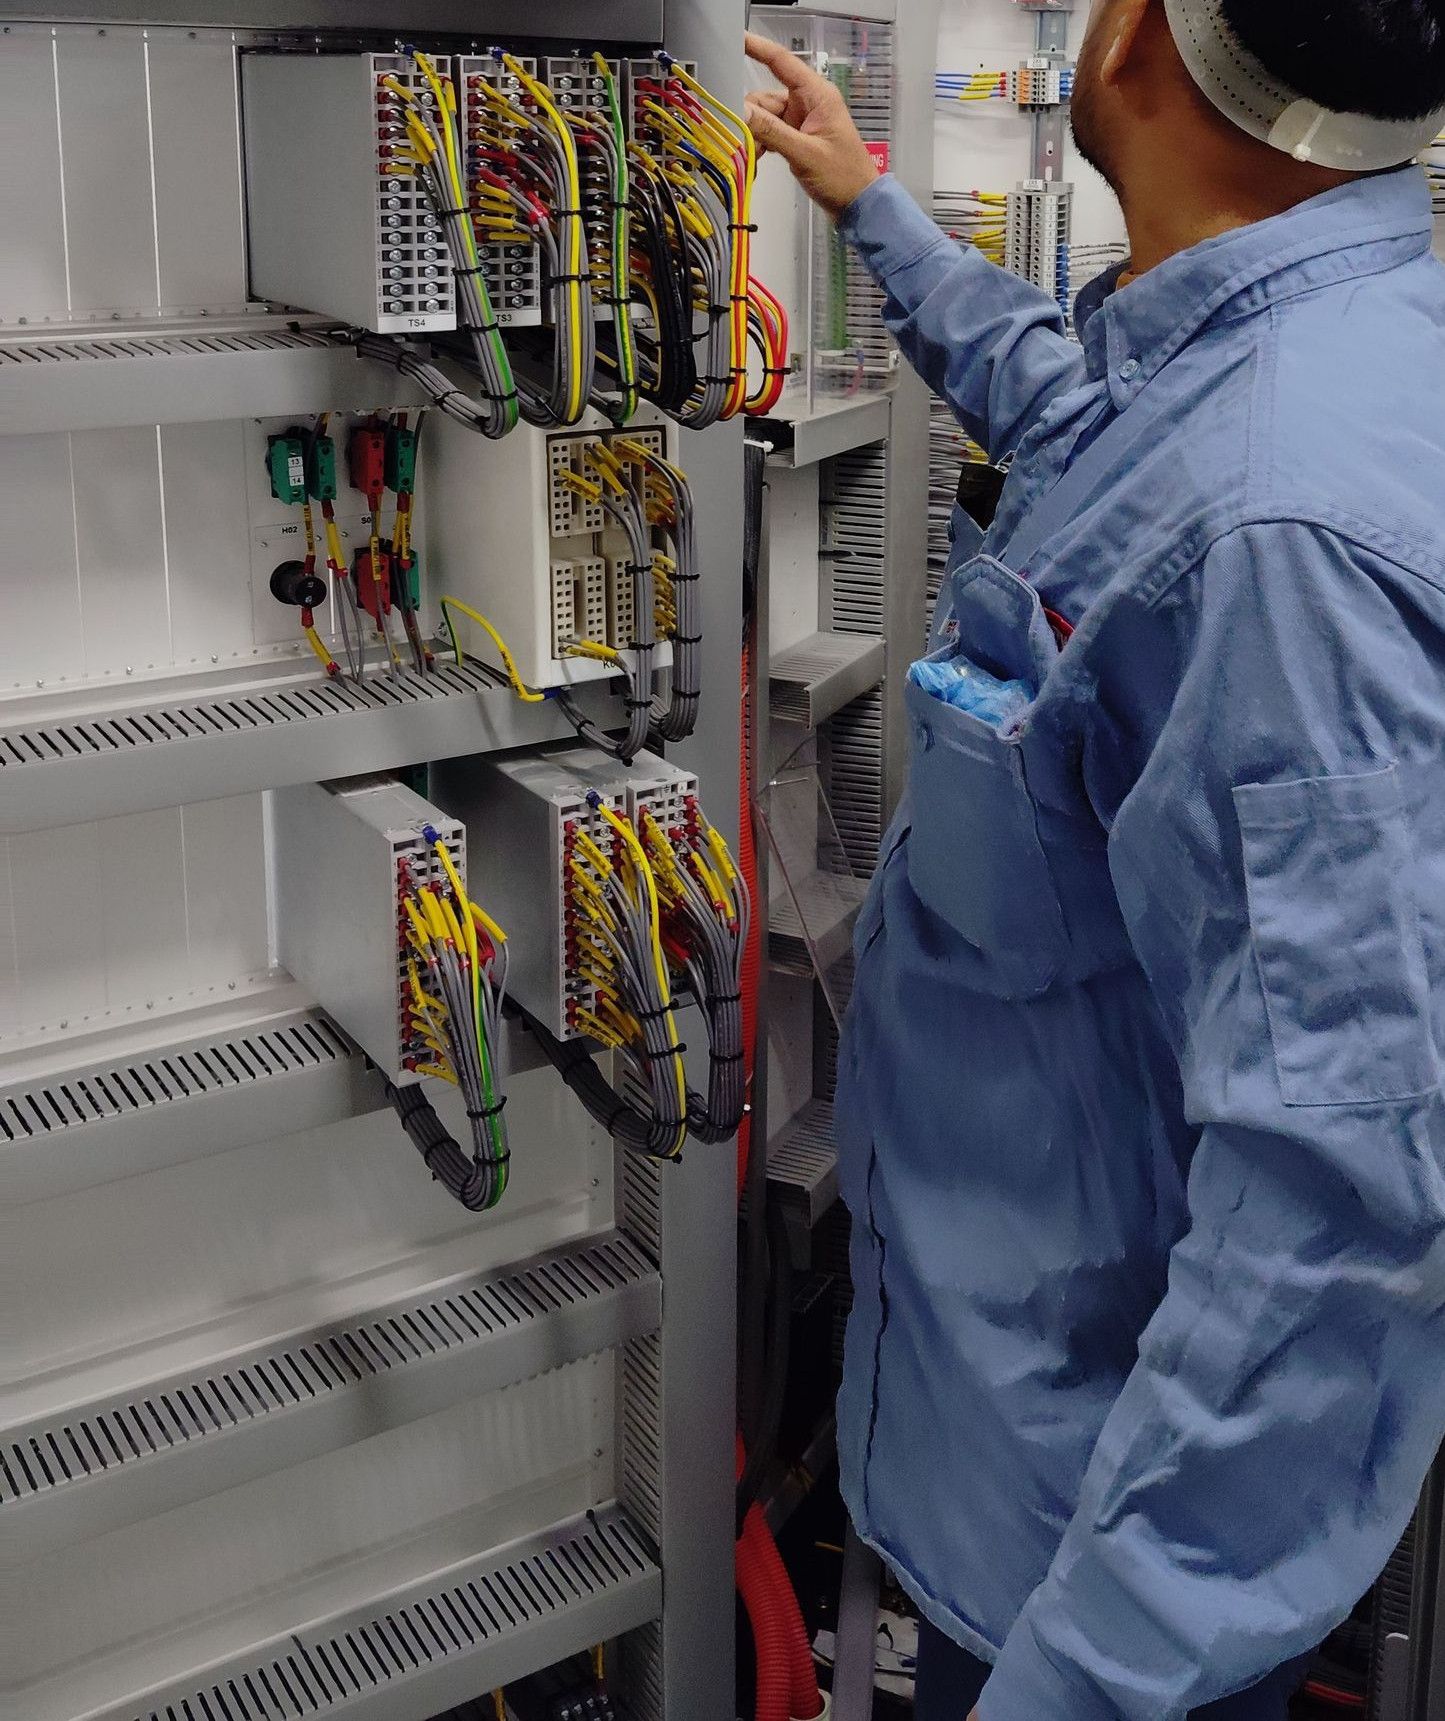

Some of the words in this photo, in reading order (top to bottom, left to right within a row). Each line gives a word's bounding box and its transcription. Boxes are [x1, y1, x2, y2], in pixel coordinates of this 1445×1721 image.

[496, 314, 512, 322] TS3
[408, 319, 426, 327] TS4
[282, 526, 298, 534] H02
